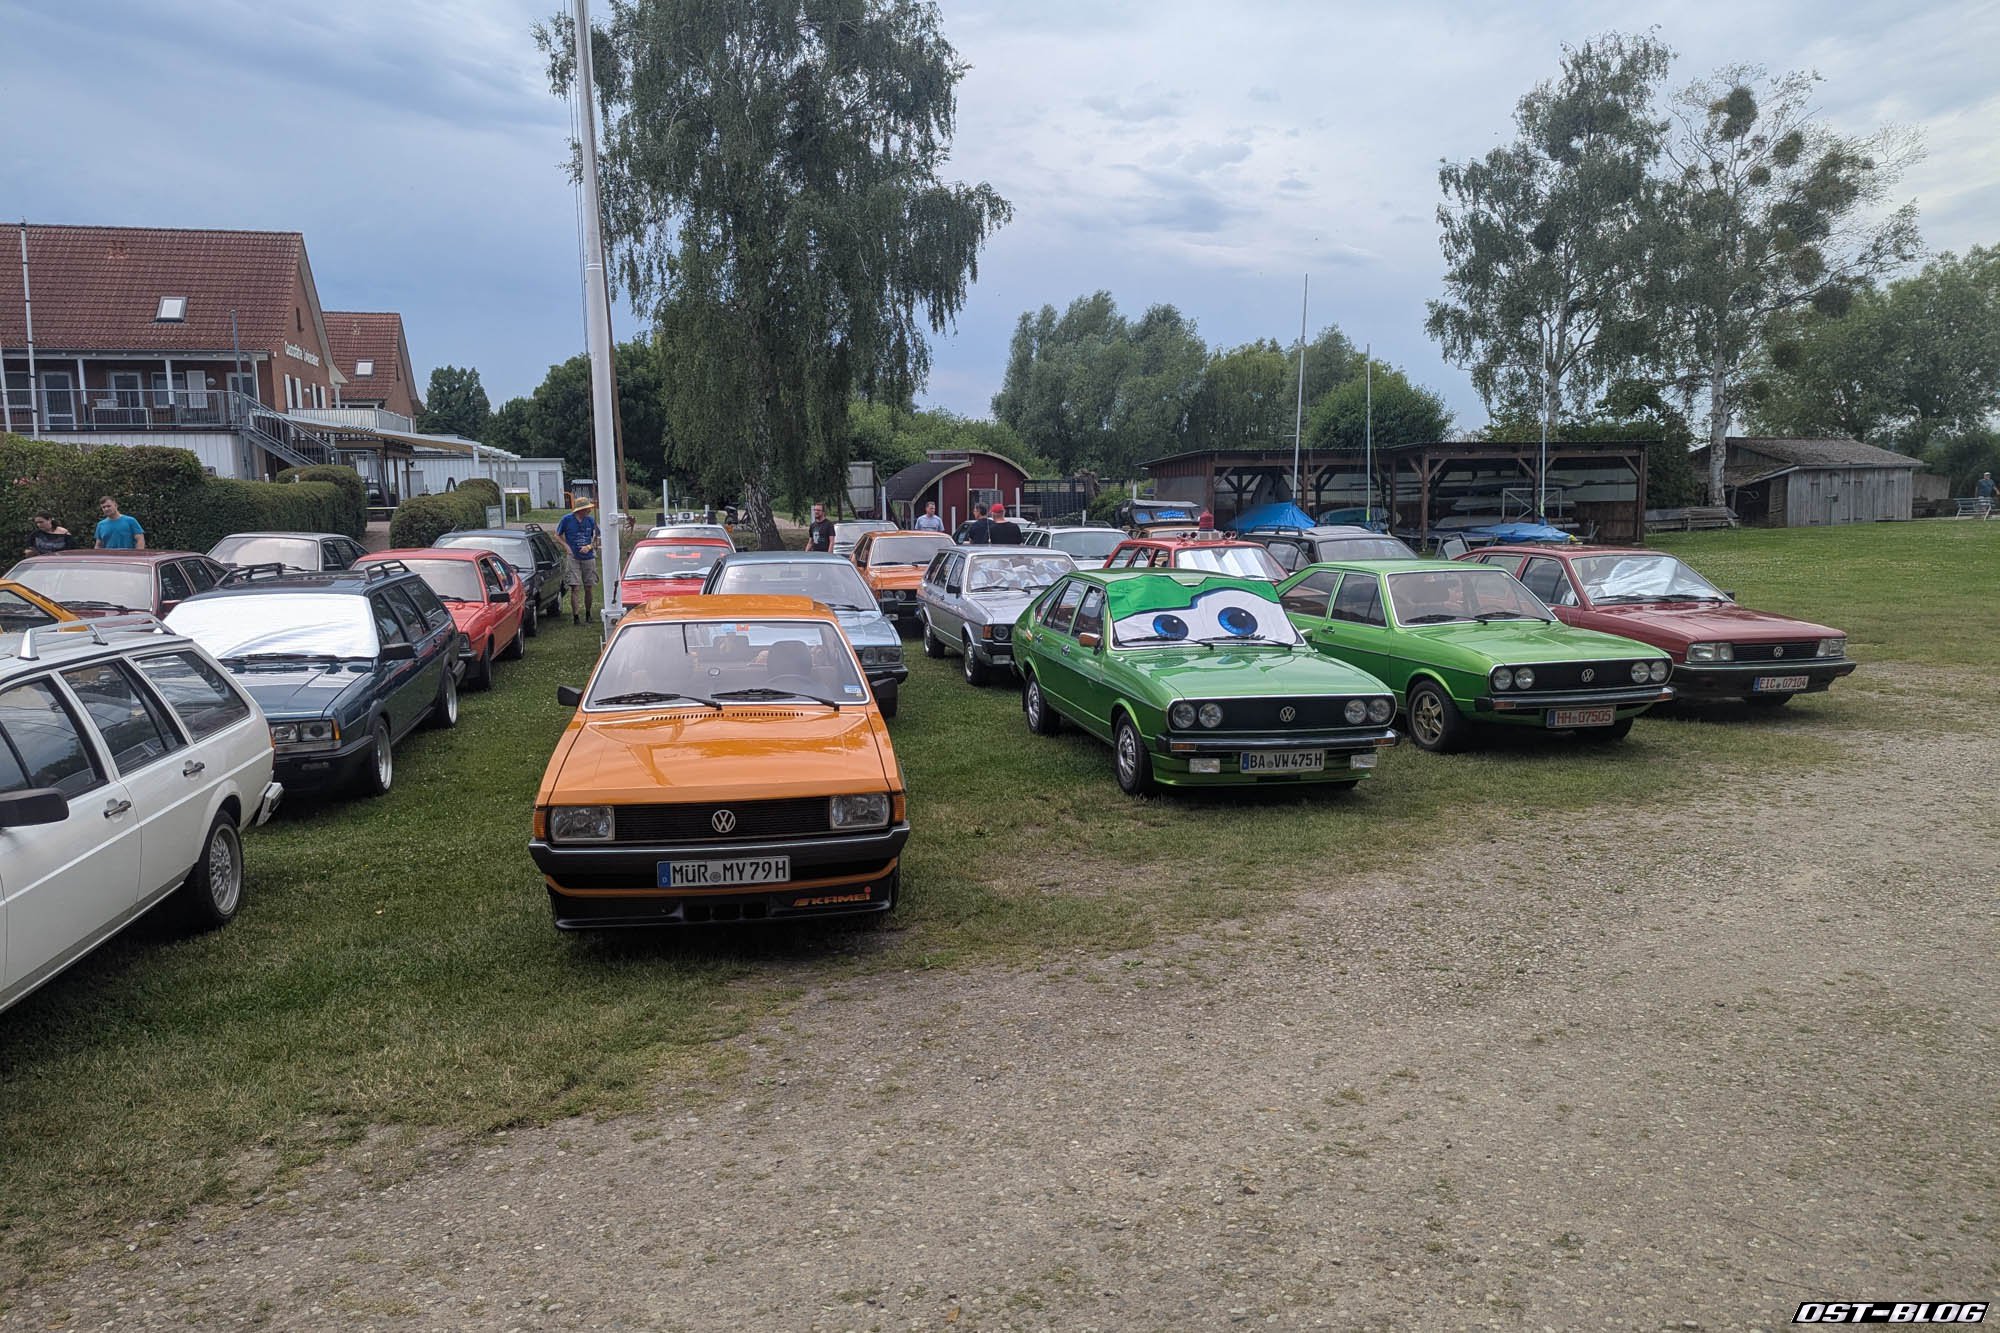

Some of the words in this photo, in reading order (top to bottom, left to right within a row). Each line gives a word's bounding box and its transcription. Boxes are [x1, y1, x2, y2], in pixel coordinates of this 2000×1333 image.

[1557, 711, 1572, 724] HH
[1250, 754, 1265, 769] BA
[711, 809, 736, 833] VW
